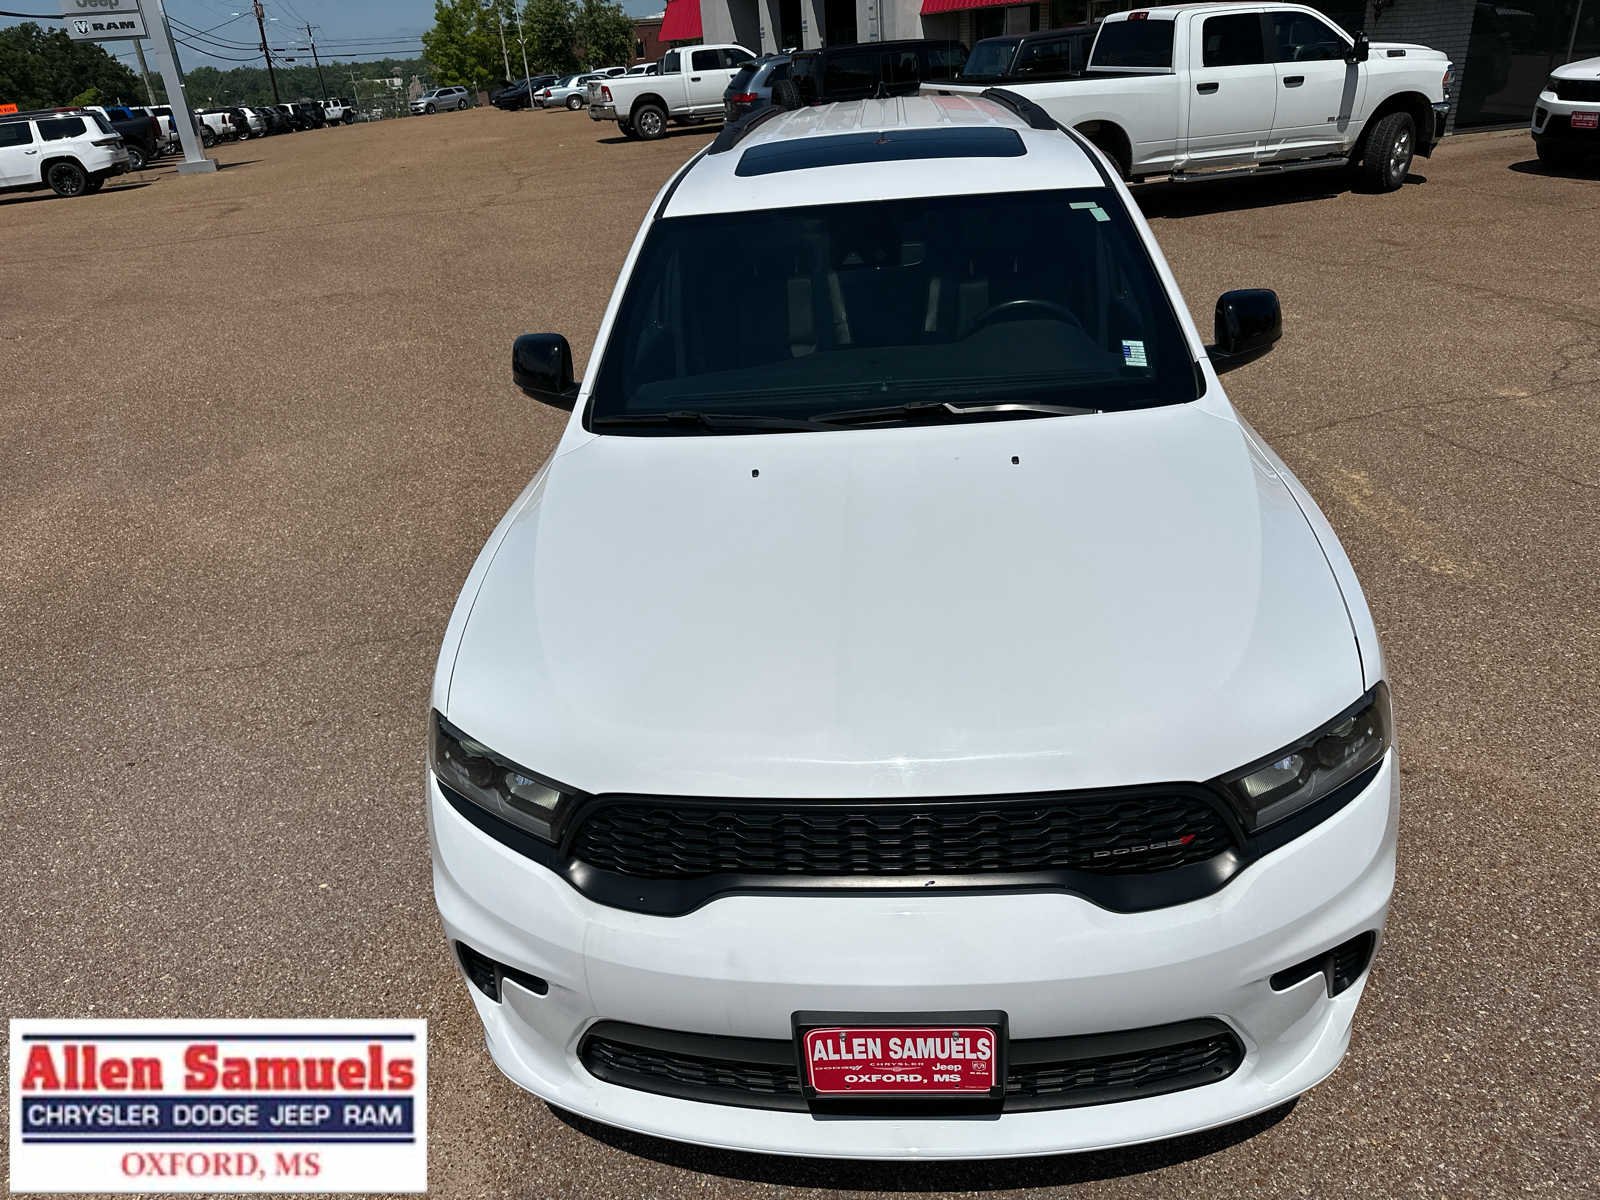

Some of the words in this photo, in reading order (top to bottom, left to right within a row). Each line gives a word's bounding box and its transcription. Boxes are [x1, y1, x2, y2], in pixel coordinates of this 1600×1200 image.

[92, 21, 136, 31] RAM
[1093, 839, 1183, 858] DODGE
[813, 1038, 882, 1062] ALLEN
[888, 1036, 991, 1060] SAMUELS
[932, 1062, 962, 1072] Jeep
[844, 1074, 928, 1084] OXFORD,
[933, 1074, 961, 1082] MS
